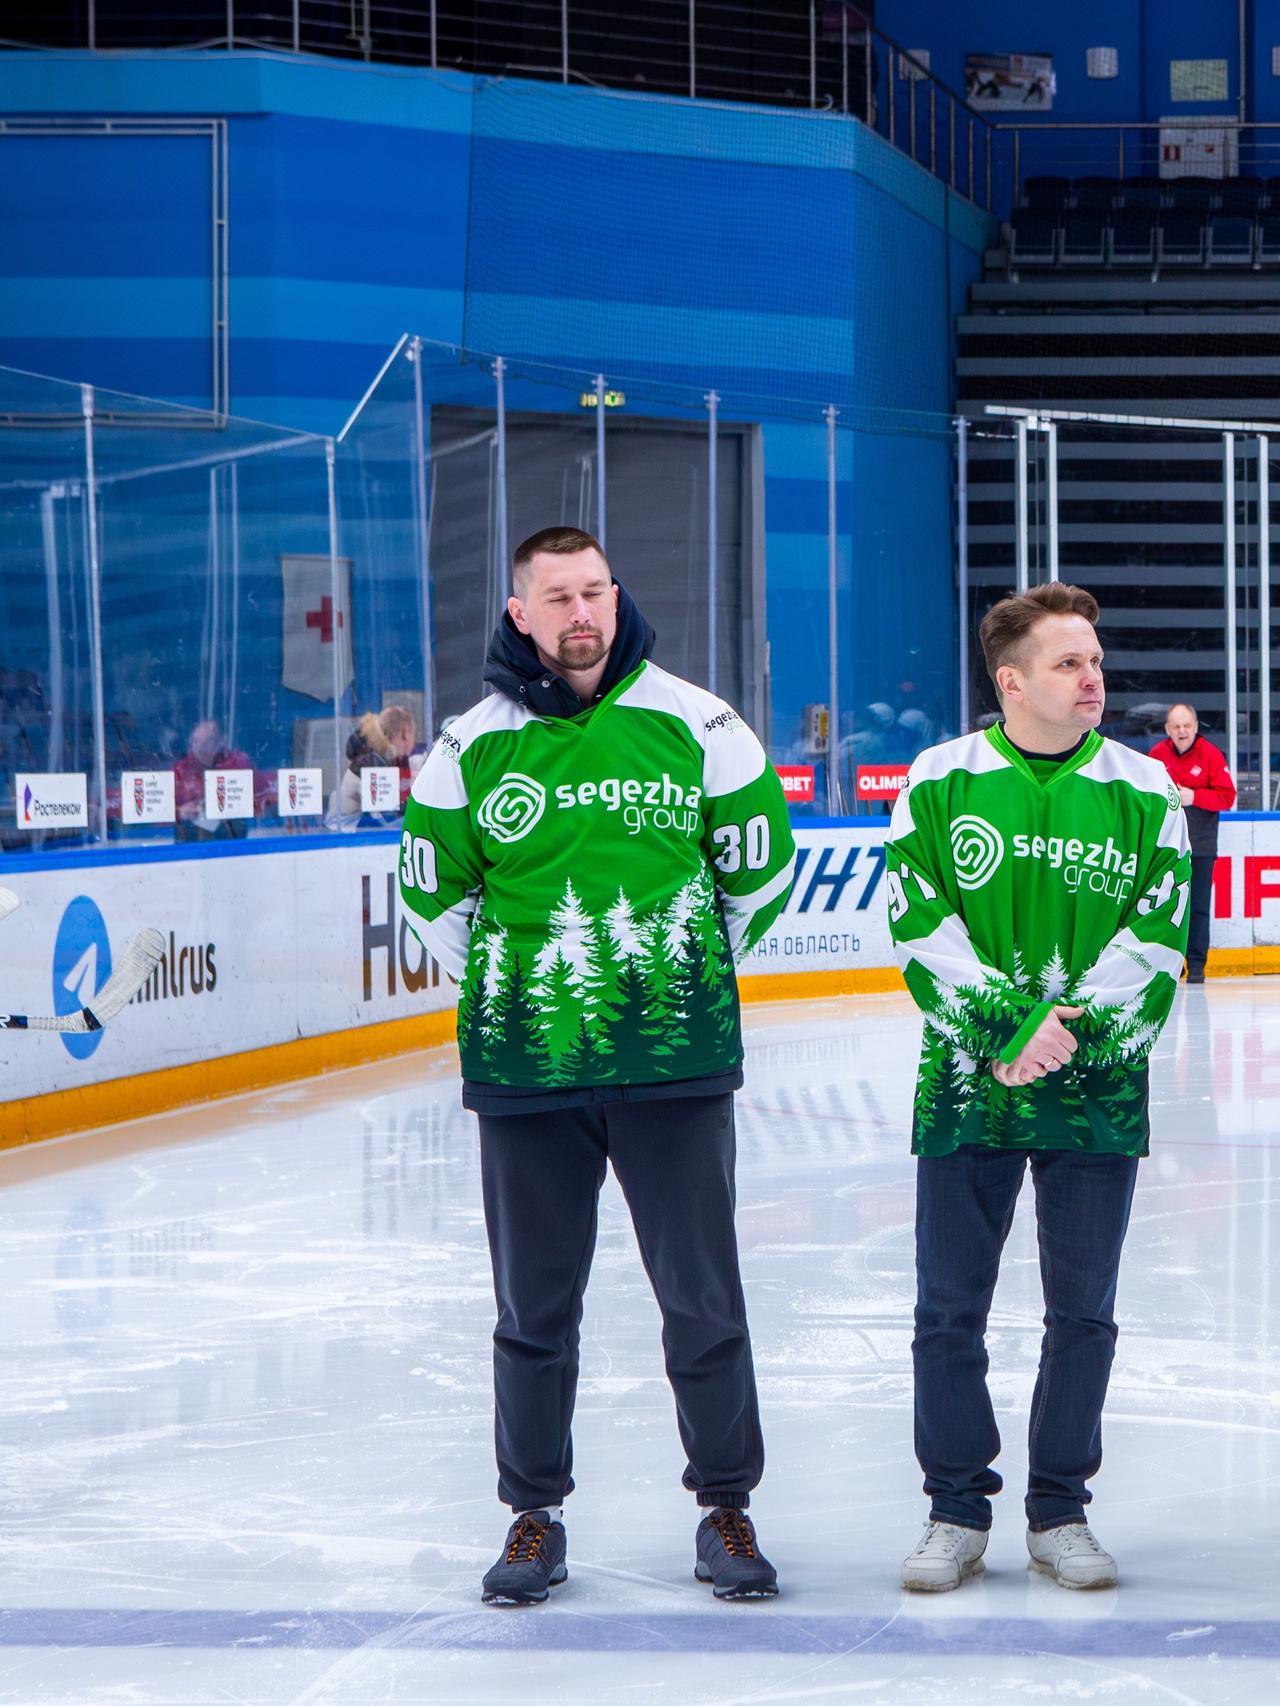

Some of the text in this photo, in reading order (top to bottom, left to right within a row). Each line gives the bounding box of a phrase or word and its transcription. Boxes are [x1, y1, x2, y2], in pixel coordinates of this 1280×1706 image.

[34, 800, 82, 816] Ростелеком
[555, 773, 702, 811] segezha
[623, 806, 699, 838] group
[401, 829, 439, 894] 30
[712, 813, 770, 873] 30
[1012, 835, 1138, 877] segezha
[784, 933, 860, 955] ОБЛАСТЬ
